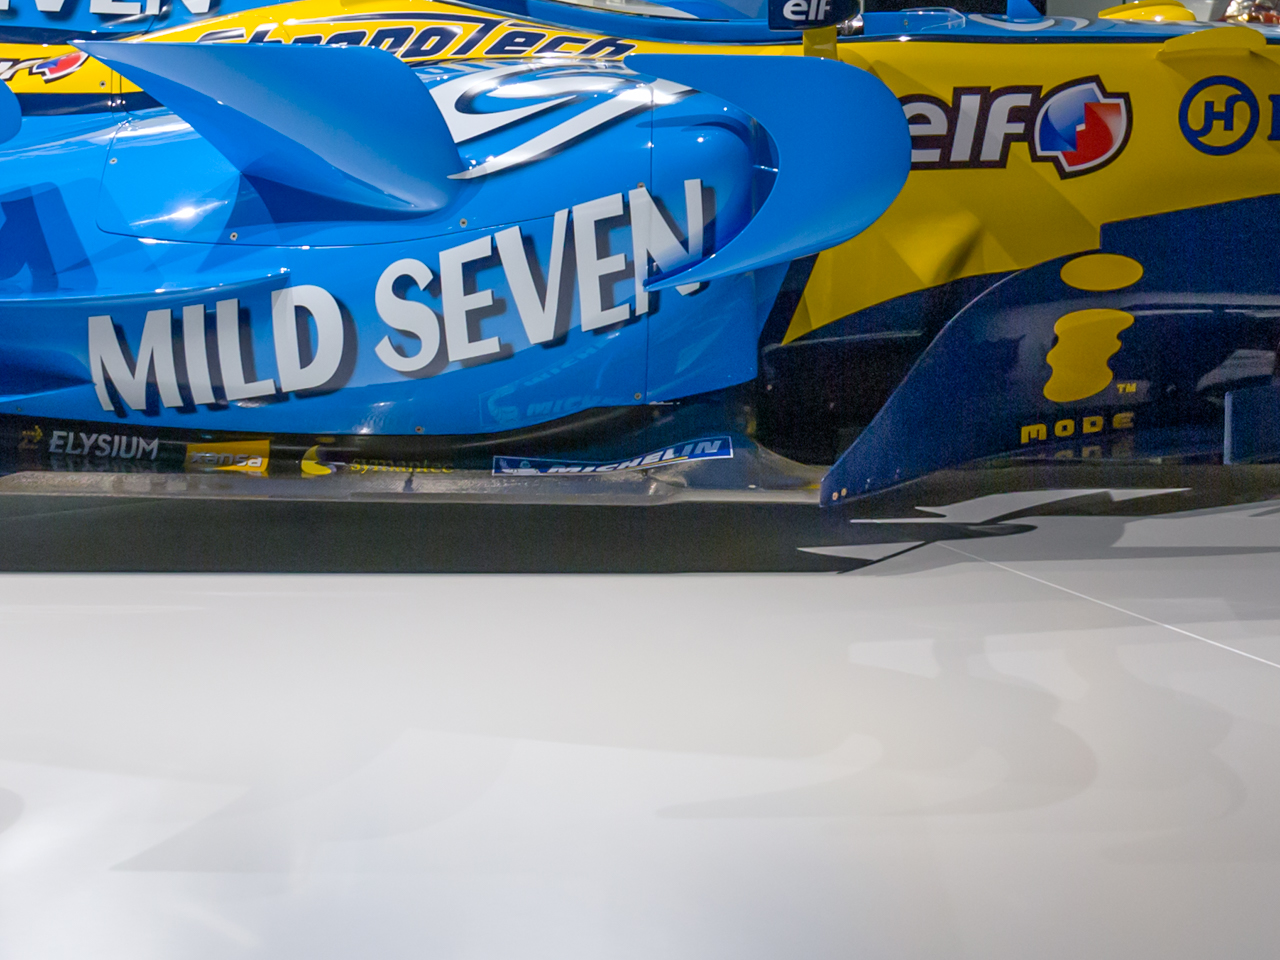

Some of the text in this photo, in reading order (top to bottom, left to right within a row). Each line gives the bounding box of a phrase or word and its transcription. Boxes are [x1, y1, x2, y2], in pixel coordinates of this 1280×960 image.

[200, 15, 637, 59] onoTech
[902, 93, 1032, 162] elf
[88, 179, 705, 412] MILD SEVEN
[49, 431, 159, 460] ELYSIUM
[191, 451, 262, 467] xansa
[547, 440, 721, 473] MICHELIN
